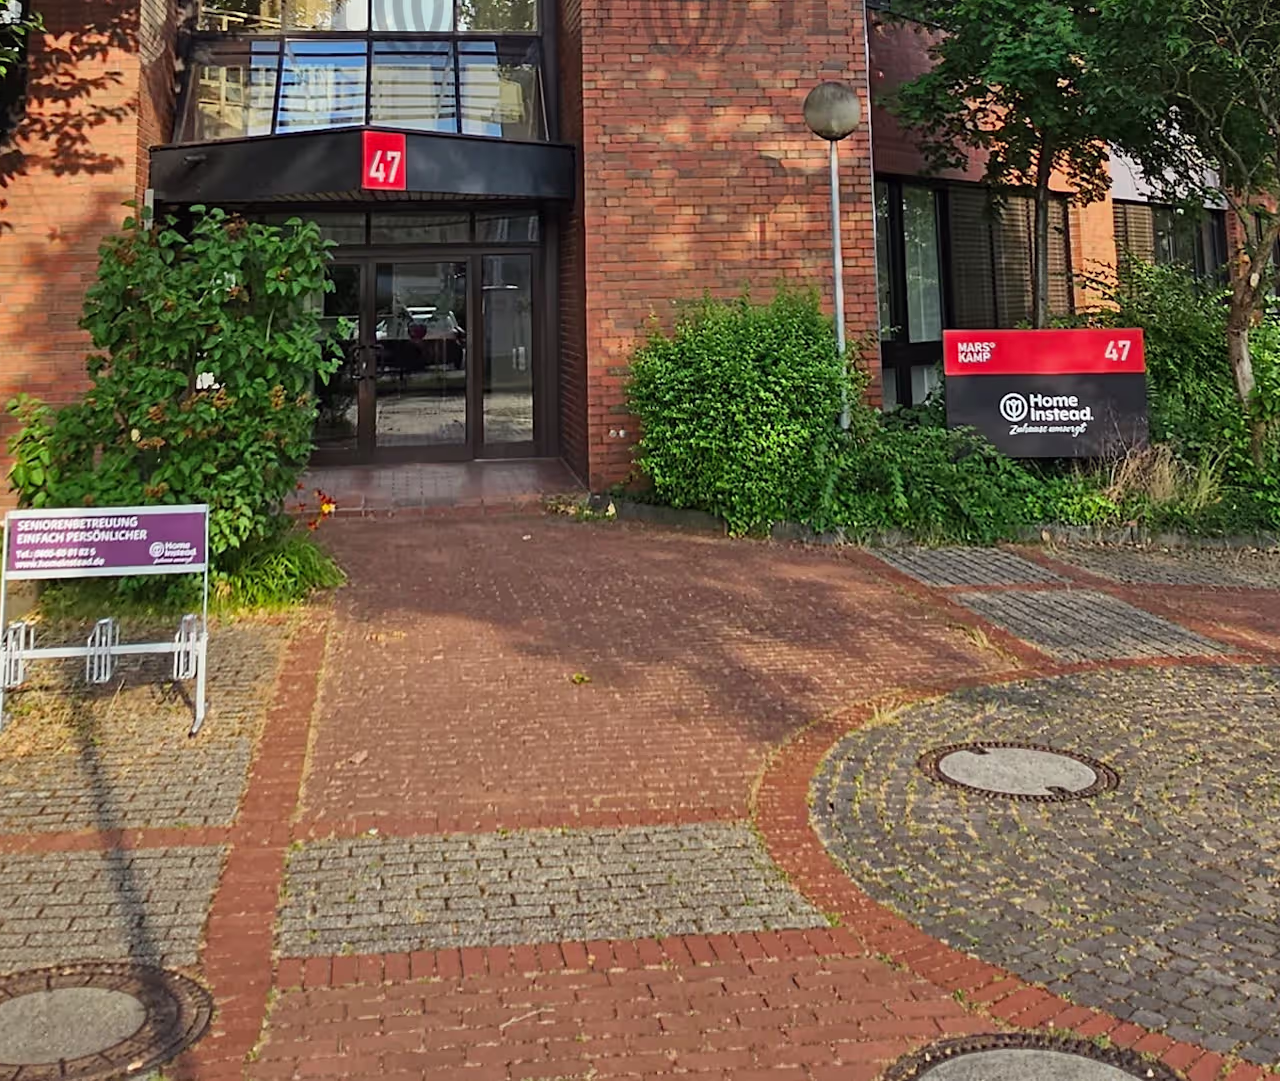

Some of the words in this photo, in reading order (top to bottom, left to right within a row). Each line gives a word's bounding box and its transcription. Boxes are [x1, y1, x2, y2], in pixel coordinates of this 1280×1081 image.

[369, 149, 401, 183] 47
[958, 352, 991, 363] KAMP
[1104, 340, 1131, 362] 47
[1029, 393, 1079, 408] Home
[1030, 406, 1095, 421] Instead.
[17, 516, 138, 532] SENIORENBETREUUNG
[16, 532, 65, 544] EINFACH
[66, 529, 148, 543] PERSÖNLICHER
